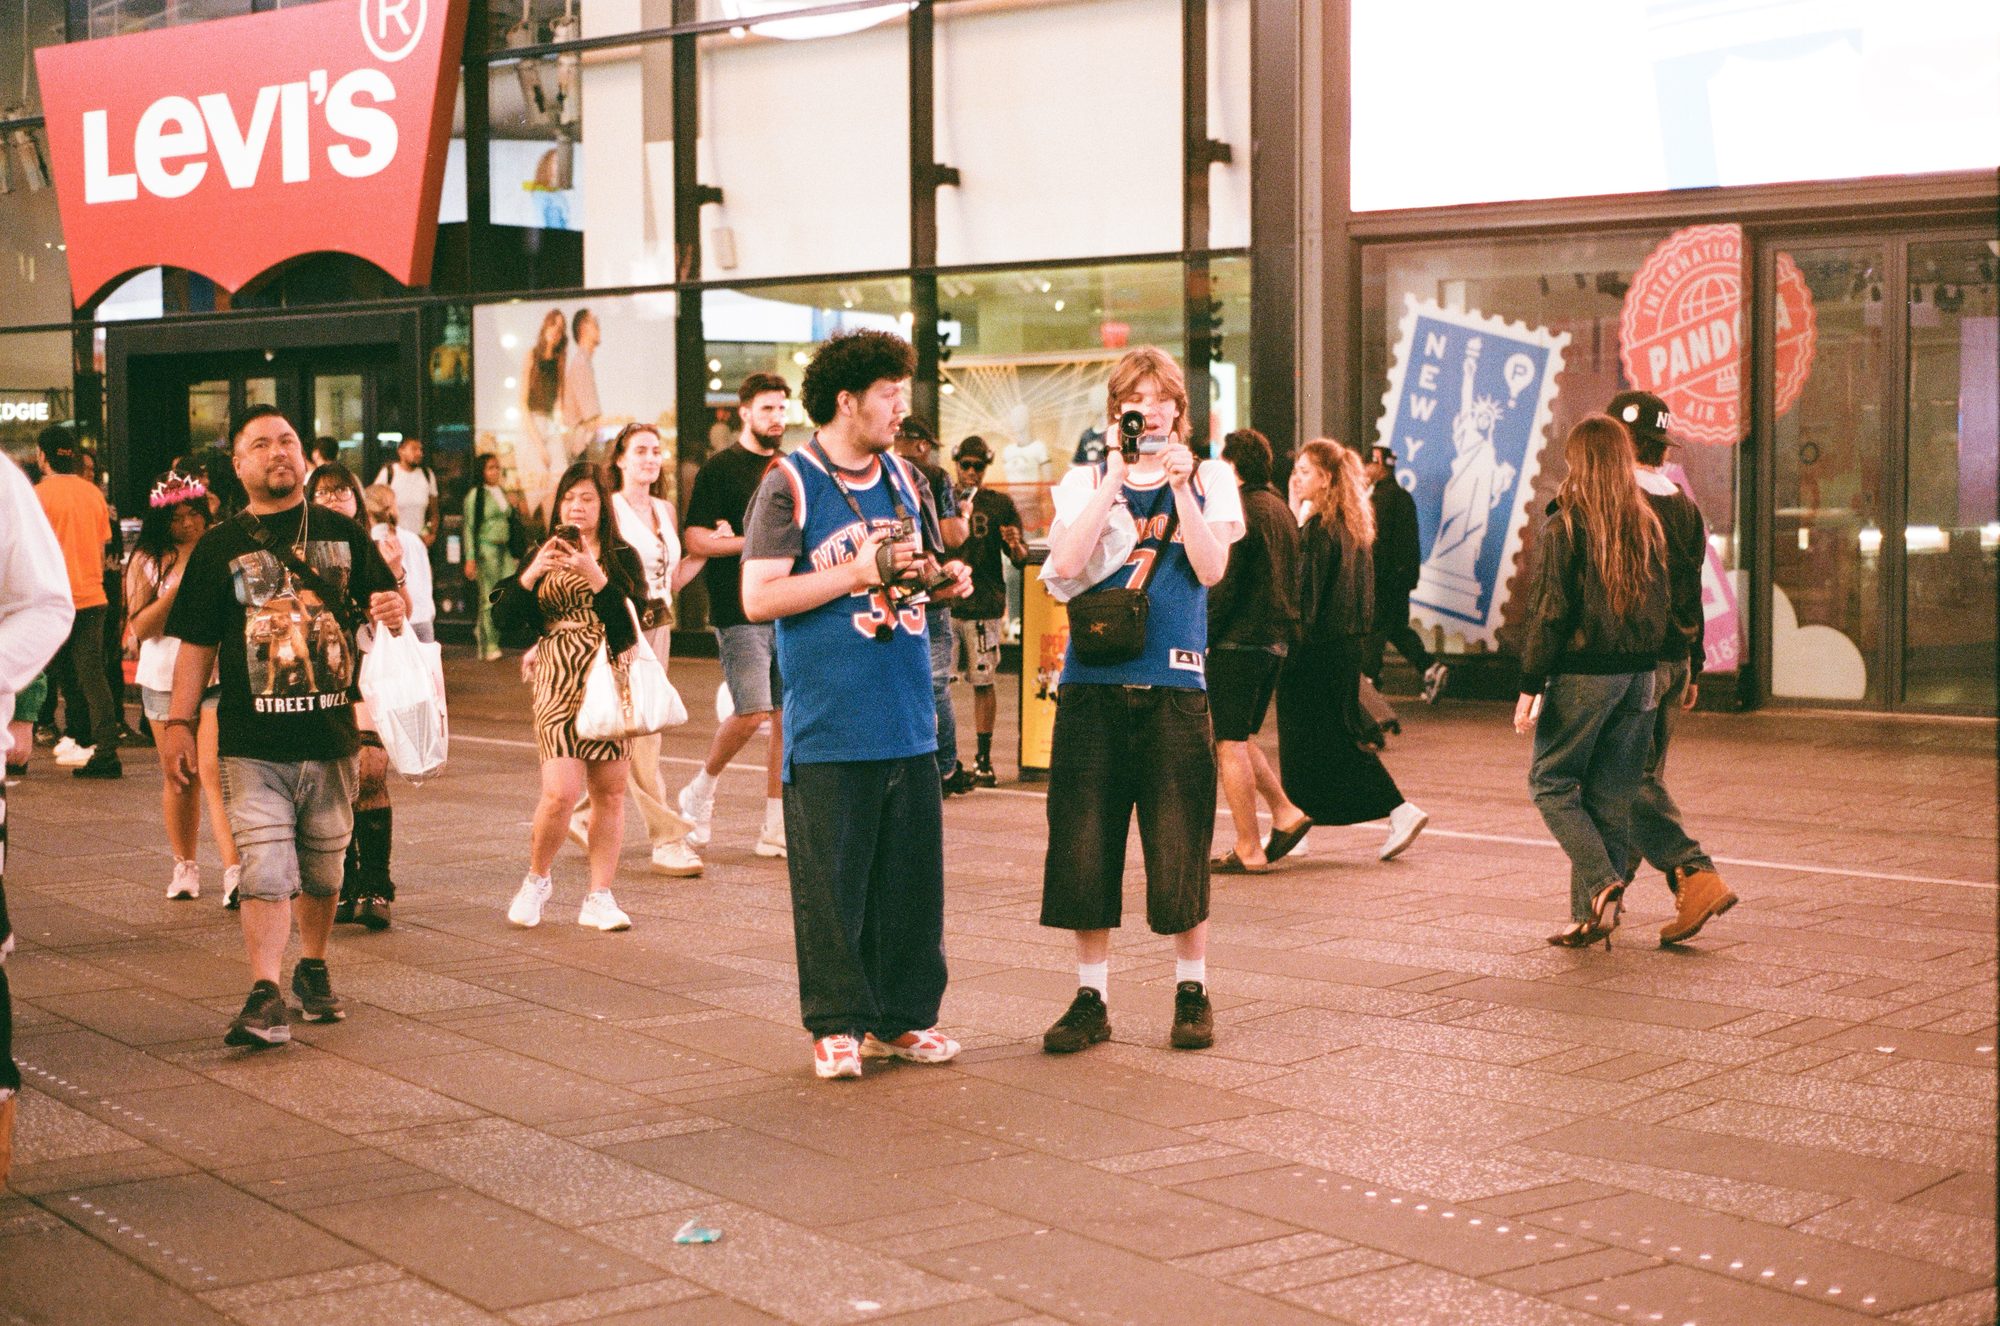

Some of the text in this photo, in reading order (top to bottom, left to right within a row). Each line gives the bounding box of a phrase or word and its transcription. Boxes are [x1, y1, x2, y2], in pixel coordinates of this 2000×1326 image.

[1683, 402, 1715, 421] AIR
[1395, 436, 1424, 492] YO
[1124, 547, 1157, 589] 7
[255, 696, 315, 713] STREET
